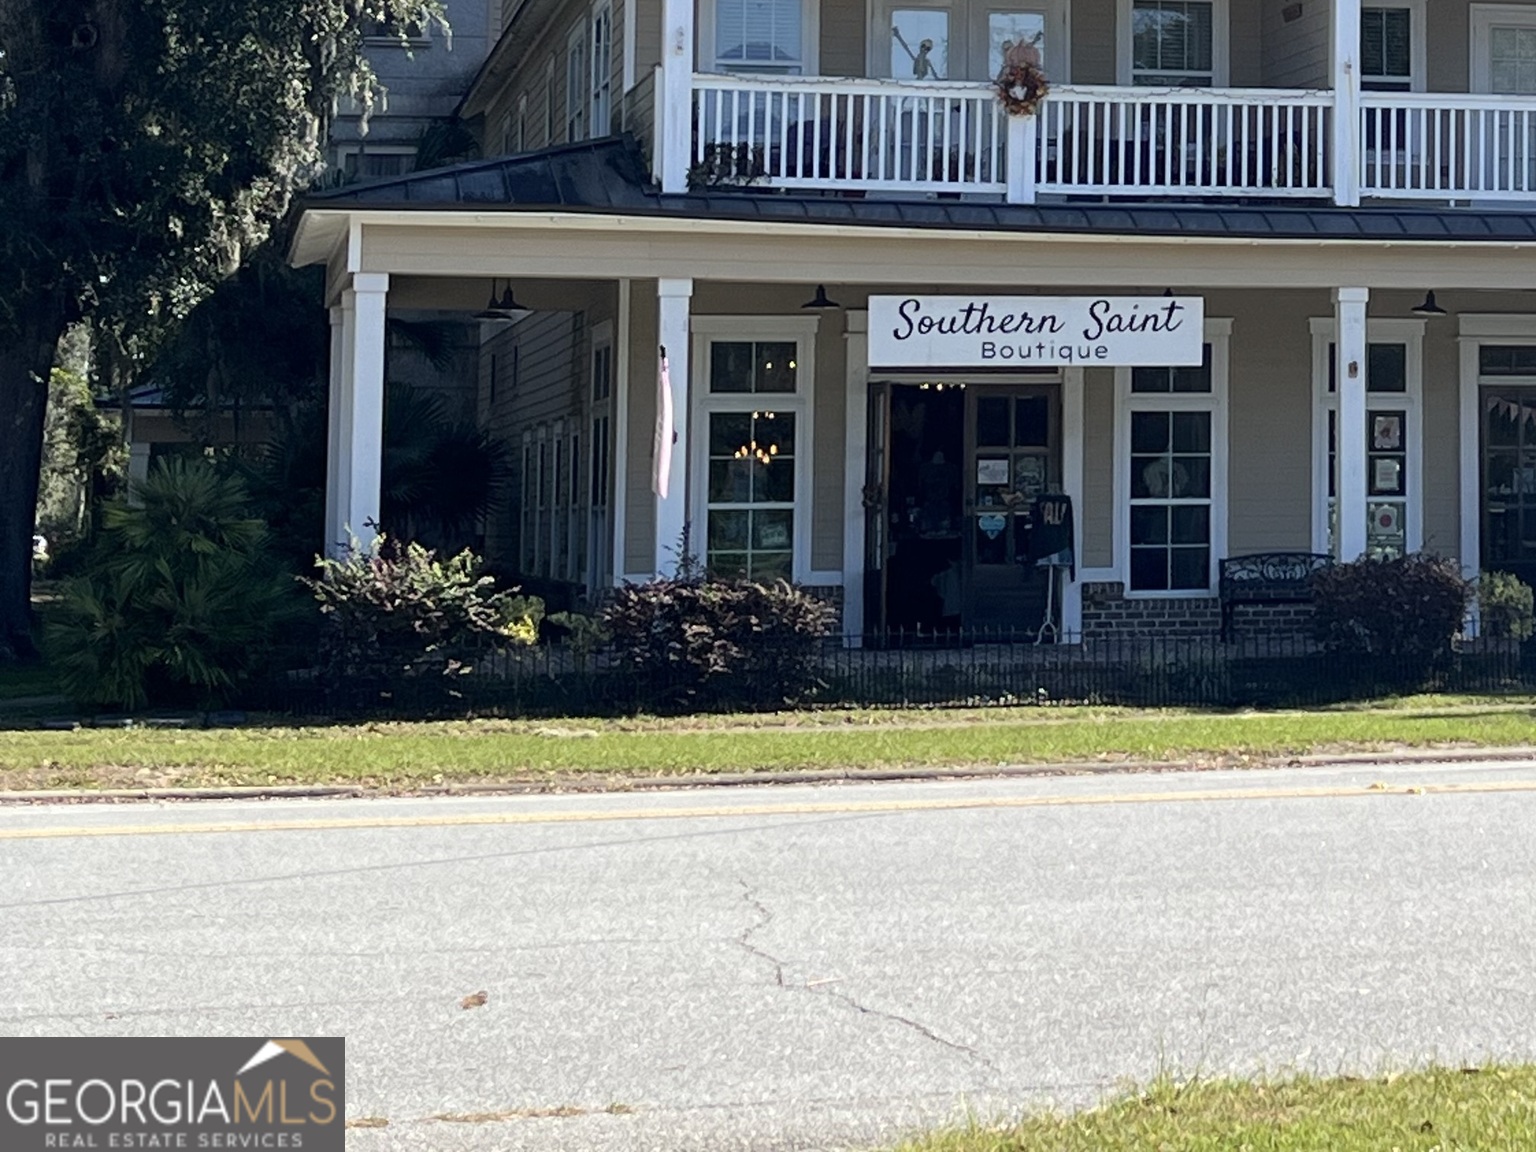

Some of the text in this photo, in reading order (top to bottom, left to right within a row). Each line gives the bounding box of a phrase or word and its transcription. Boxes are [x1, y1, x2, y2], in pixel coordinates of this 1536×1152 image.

[893, 299, 1184, 340] Southern Saint
[981, 341, 1109, 363] Boutique
